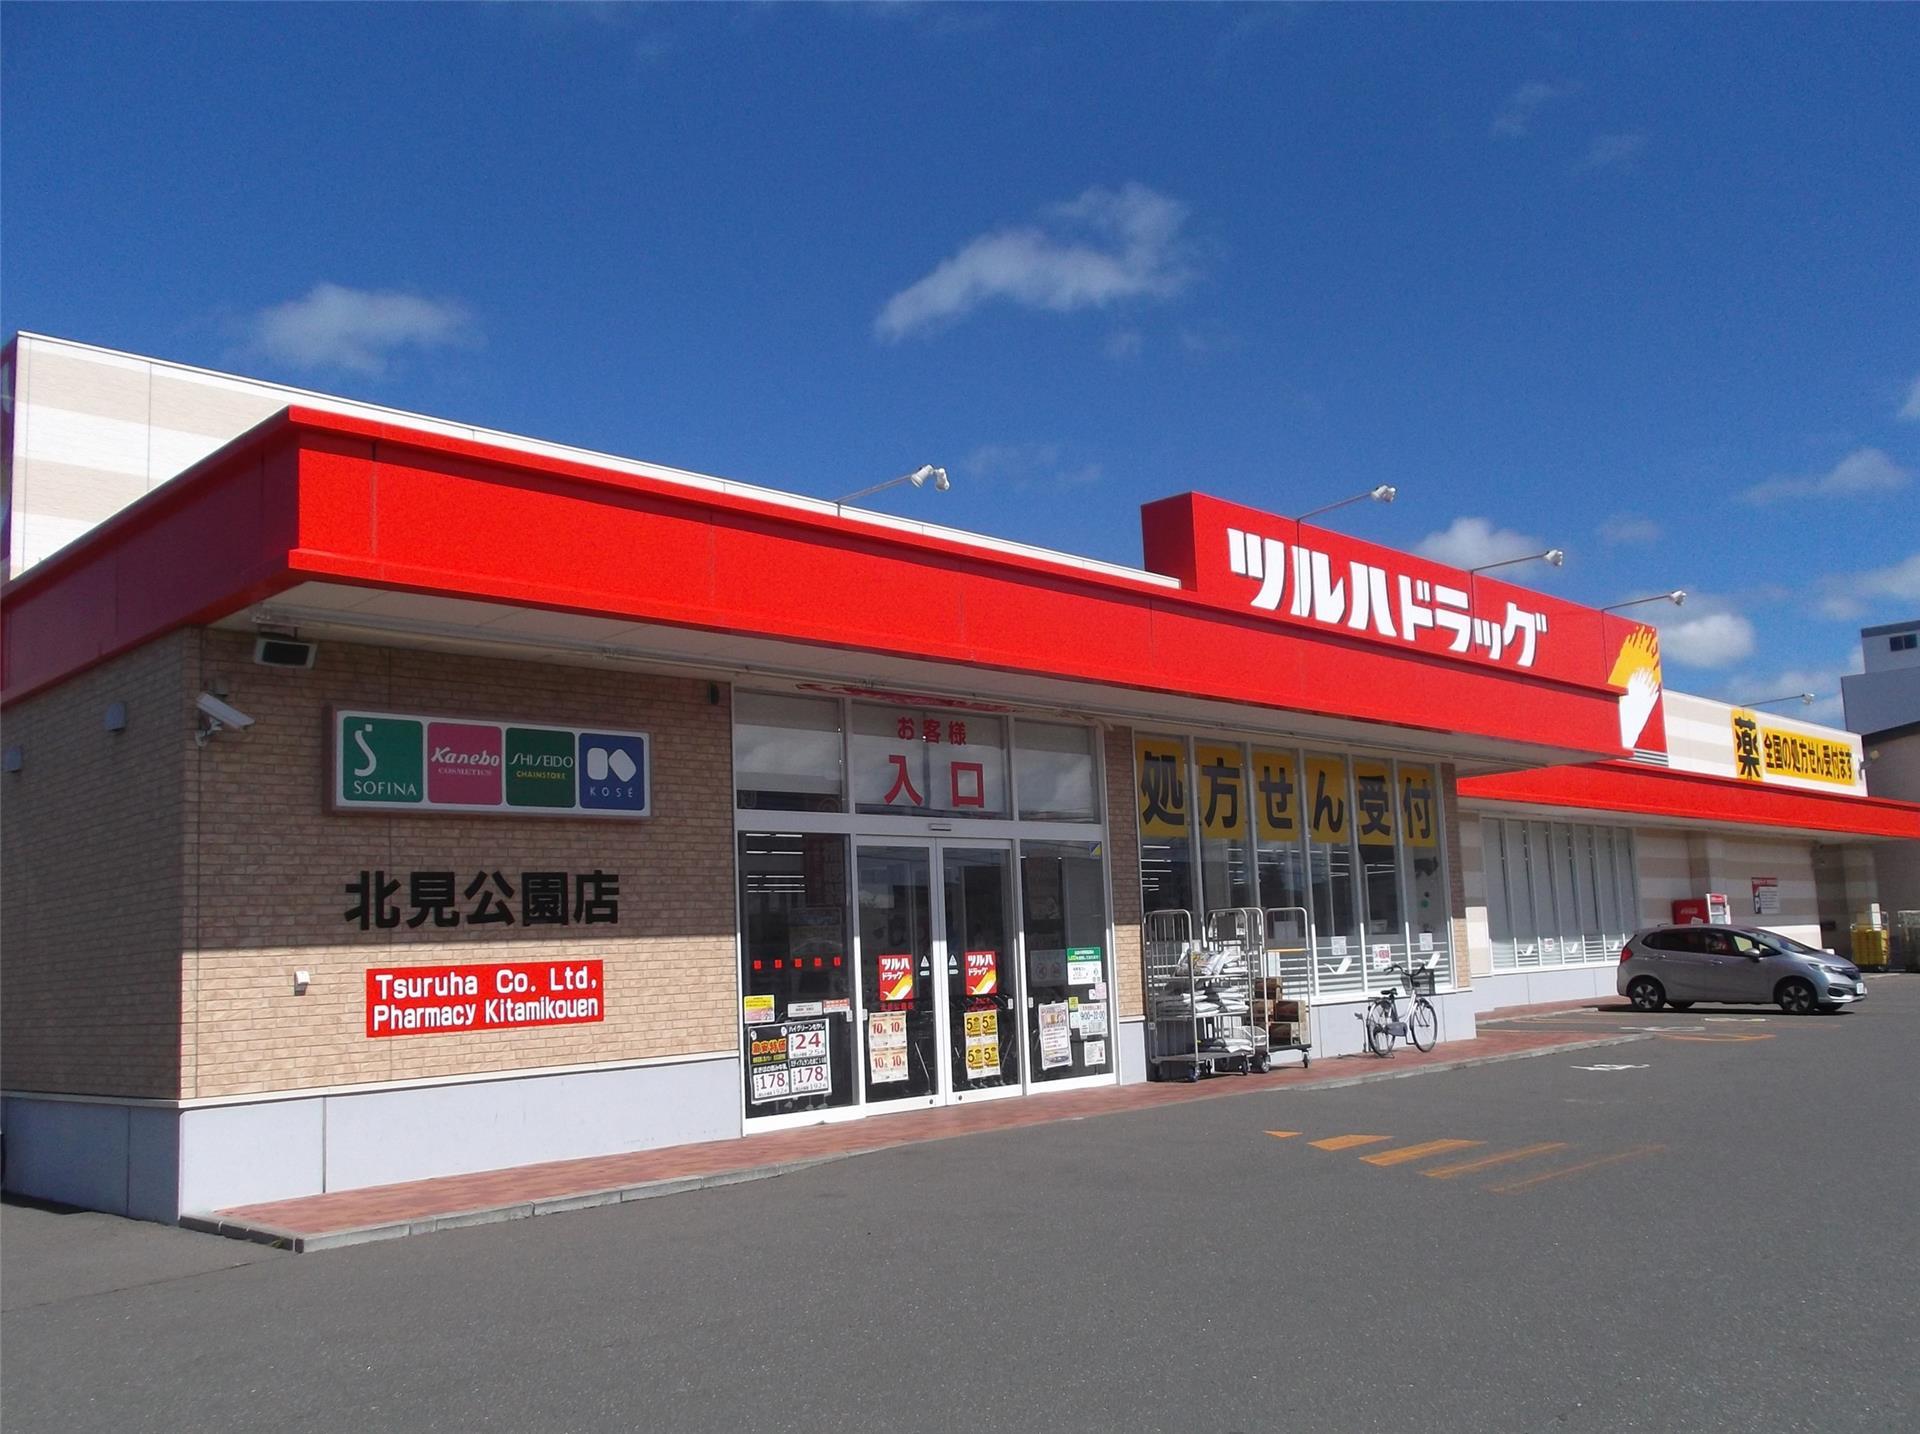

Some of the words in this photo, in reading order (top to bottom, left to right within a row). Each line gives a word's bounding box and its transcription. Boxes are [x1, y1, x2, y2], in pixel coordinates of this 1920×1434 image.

[1227, 527, 1548, 667] ツルハドラッグ
[896, 716, 967, 747] お客様
[1734, 716, 1761, 778] 薬
[1763, 732, 1853, 780] 全国の処方せん受付ます
[431, 746, 500, 768] Kanebo
[509, 752, 574, 769] SHISEIDO
[438, 767, 493, 777] COSMETICS
[516, 769, 567, 781] CHAINSTORE
[353, 780, 417, 797] SOFINA
[884, 754, 984, 809] 入口
[1141, 751, 1434, 840] 処方せん受付
[343, 869, 620, 931] 北見公園店
[881, 957, 910, 970] ツルハ
[967, 954, 994, 966] ツルハ
[882, 971, 905, 981] ドラッグ
[968, 967, 987, 977] ドラッグ
[375, 972, 478, 1000] Tsuruha
[496, 969, 536, 993] Co.
[374, 1001, 477, 1031] Pharmacy
[485, 997, 599, 1024] Kitamikouen
[795, 1032, 822, 1050] 24
[759, 1072, 786, 1090] 178
[797, 1066, 824, 1084] 178
